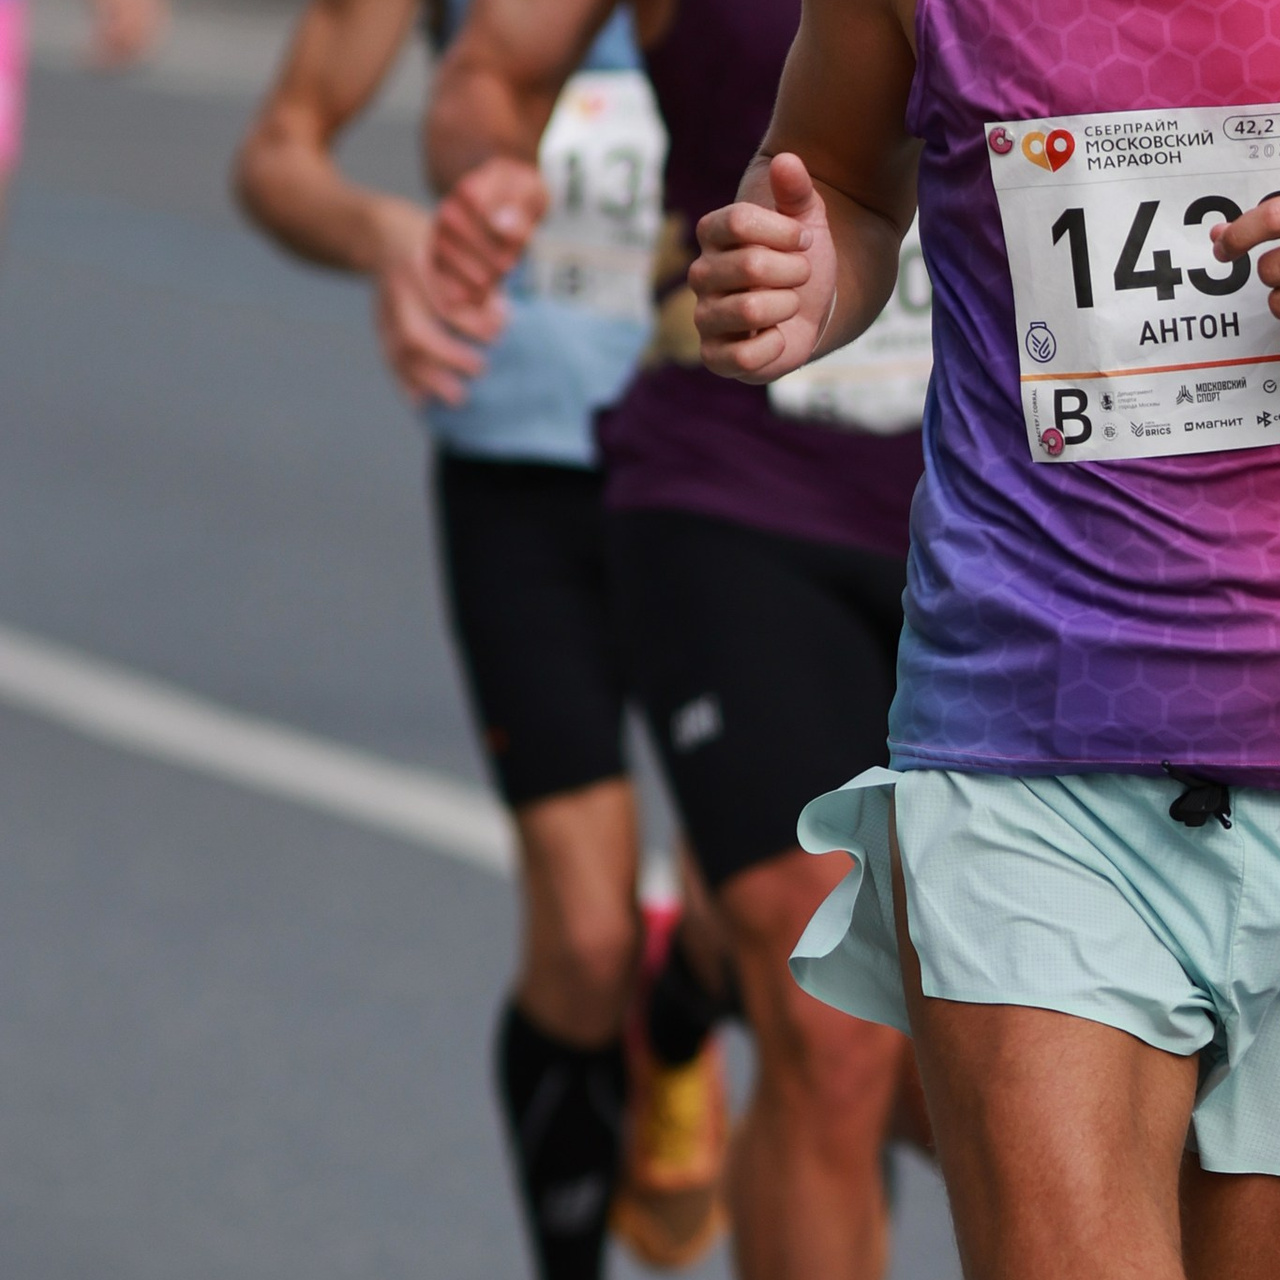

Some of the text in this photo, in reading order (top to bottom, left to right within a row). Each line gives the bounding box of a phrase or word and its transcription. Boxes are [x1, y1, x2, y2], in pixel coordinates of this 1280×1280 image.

[1084, 119, 1179, 137] СБЕРПРАЙМ
[1234, 118, 1275, 136] 42,2
[1086, 129, 1214, 154] МОСКОВСКИЙ
[1087, 150, 1182, 171] МАРАФОН
[1139, 311, 1240, 346] АНТОН
[1195, 377, 1247, 392] МОСКОВСКИЙ
[1196, 391, 1221, 403] СПОРТ
[1054, 388, 1093, 446] B
[1145, 427, 1172, 437] BRICS
